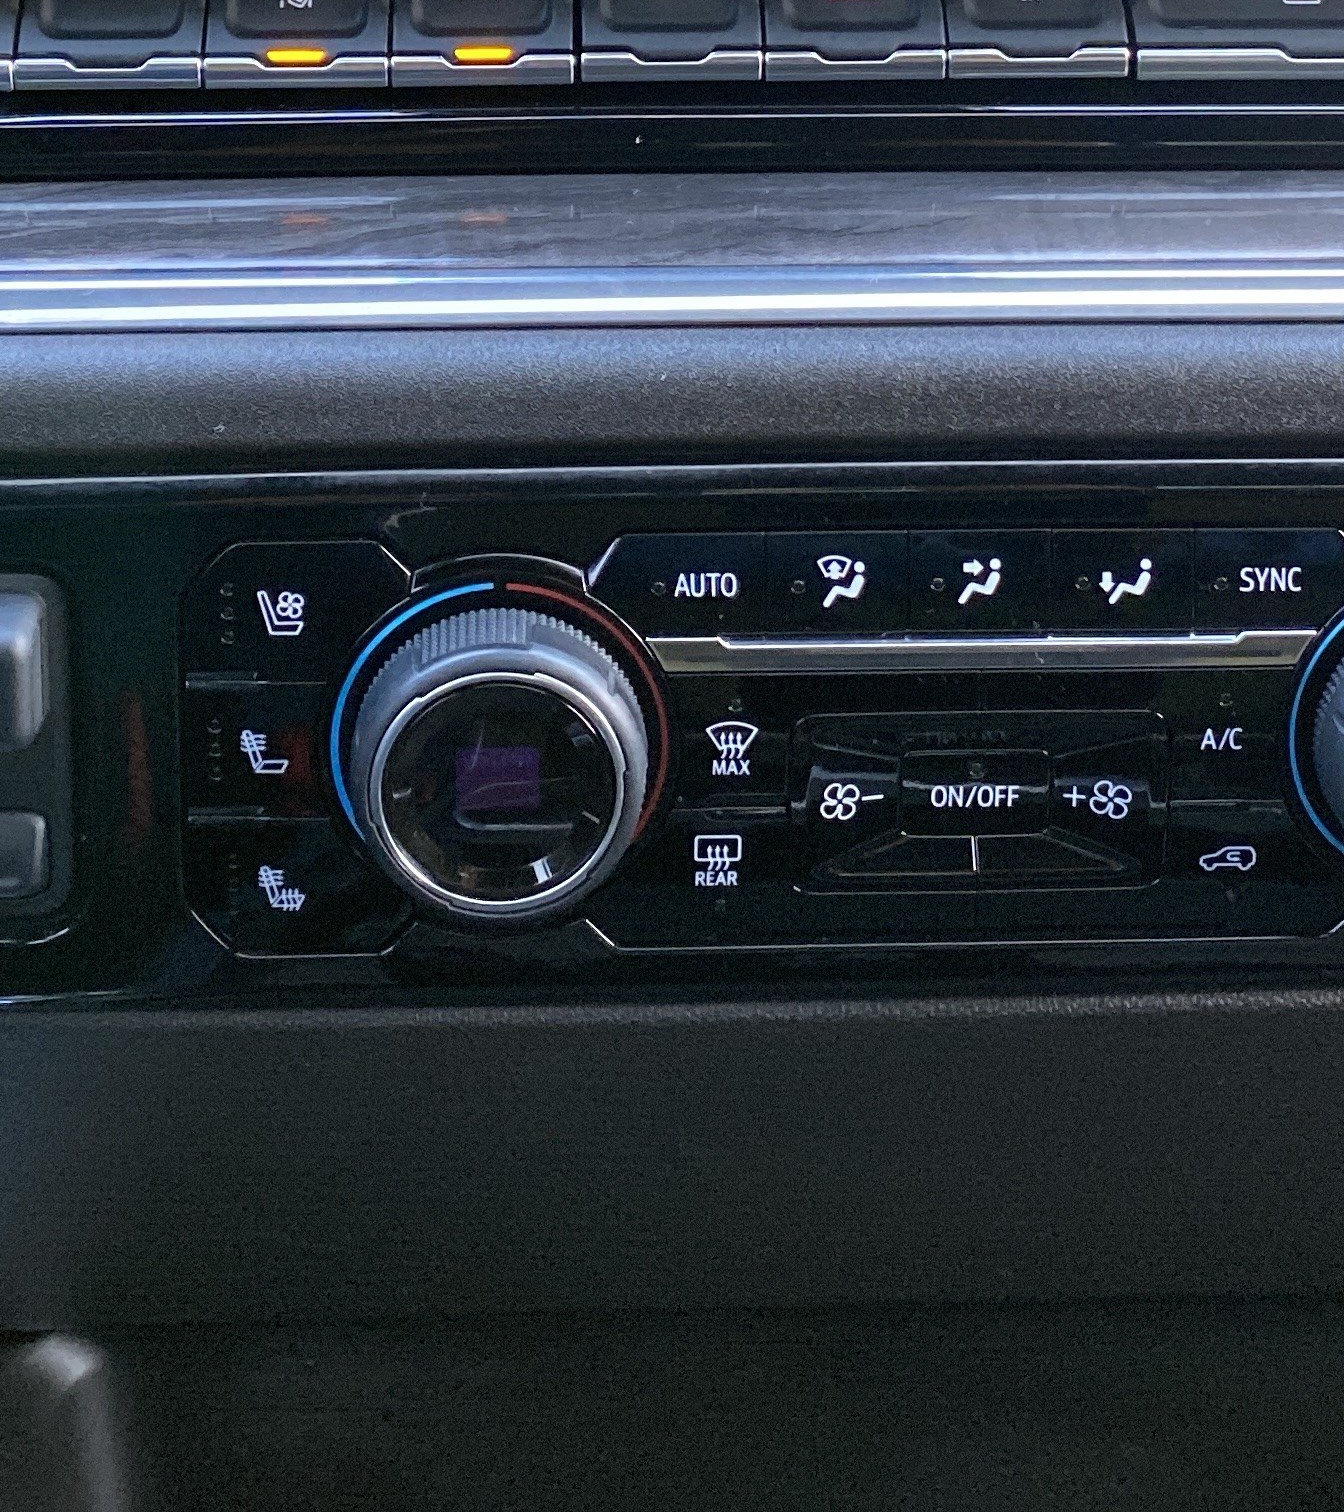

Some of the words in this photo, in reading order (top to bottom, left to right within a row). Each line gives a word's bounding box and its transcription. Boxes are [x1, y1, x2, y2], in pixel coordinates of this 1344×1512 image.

[673, 572, 738, 598] AUTO
[1239, 566, 1302, 593] SYNC
[1200, 727, 1243, 751] A/C
[711, 760, 751, 776] MAX
[929, 784, 1021, 808] ON/OFF
[694, 870, 738, 887] REAR
